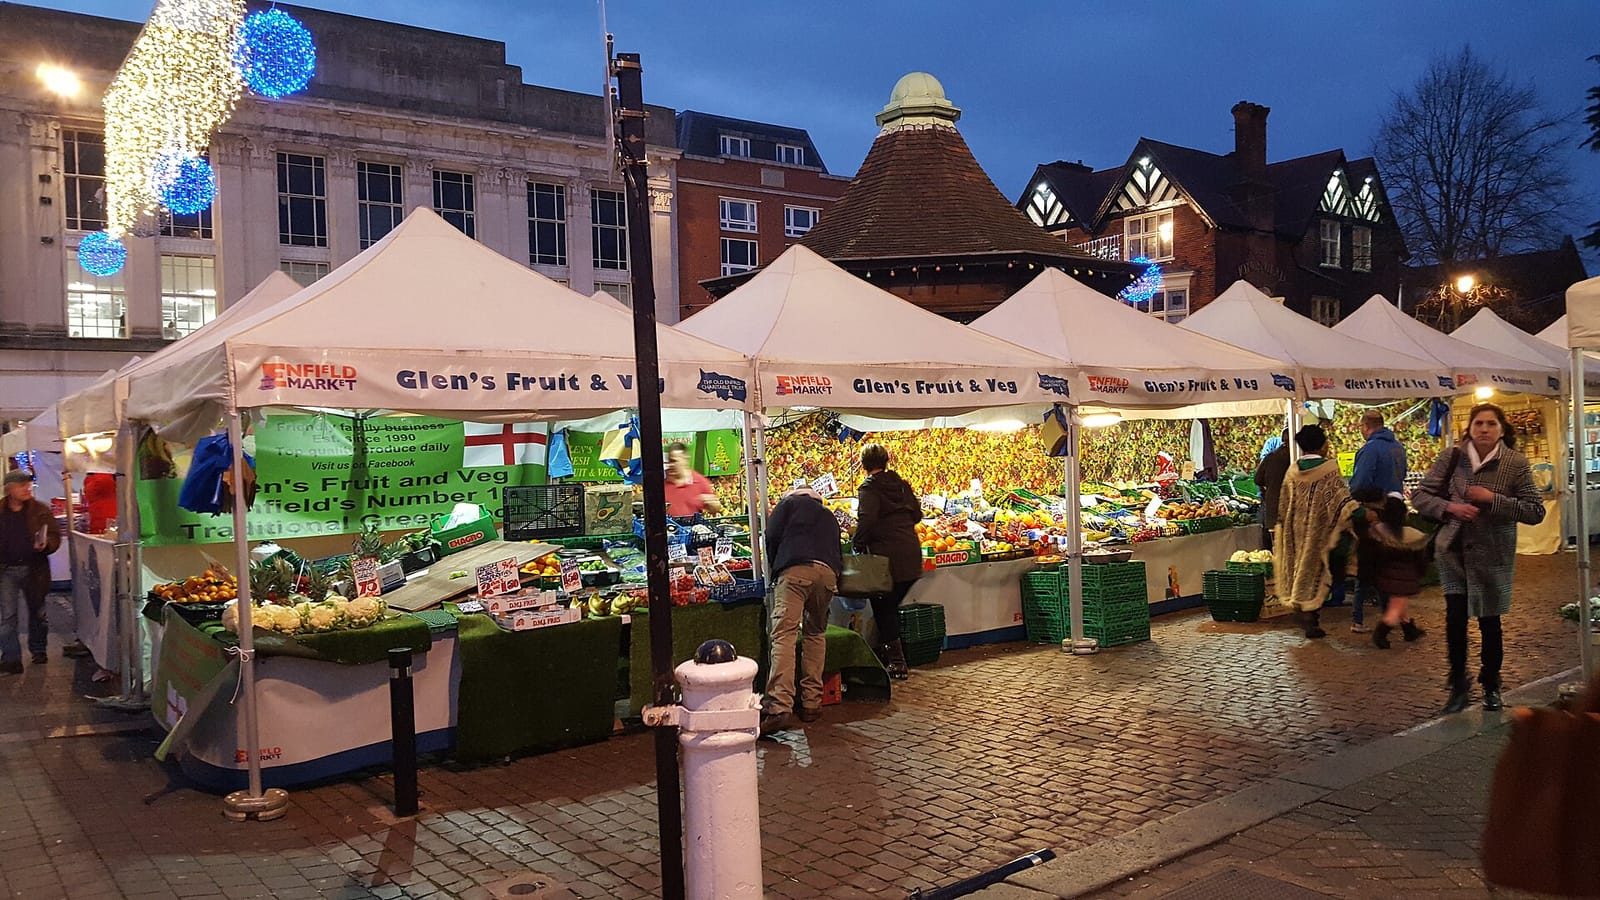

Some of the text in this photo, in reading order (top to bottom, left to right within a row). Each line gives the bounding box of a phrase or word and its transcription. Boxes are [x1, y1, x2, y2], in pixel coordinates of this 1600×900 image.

[262, 363, 357, 386] ENFIELD
[396, 370, 495, 391] Glen's
[507, 372, 580, 391] Fruit
[590, 373, 608, 391] &
[287, 378, 357, 391] MARKET
[776, 375, 831, 391] ENFIELD
[853, 379, 1017, 394] Glen's Fruit & Veg
[1088, 376, 1129, 388] ENFIELD
[1144, 378, 1258, 392] Glen's Fruit & Veg
[793, 386, 832, 395] MARKET
[384, 423, 445, 431] business
[385, 434, 416, 442] 1990
[275, 446, 302, 457] Top
[362, 445, 416, 455] produce
[420, 443, 450, 452] daily
[311, 462, 334, 471] Visit
[368, 458, 415, 468] Facebook
[598, 468, 615, 477] VEG
[321, 475, 390, 491] Fruit
[400, 472, 448, 487] and
[457, 469, 509, 484] Veg
[367, 490, 477, 508] Number
[487, 487, 497, 500] 1
[936, 552, 968, 564] EXAGRO
